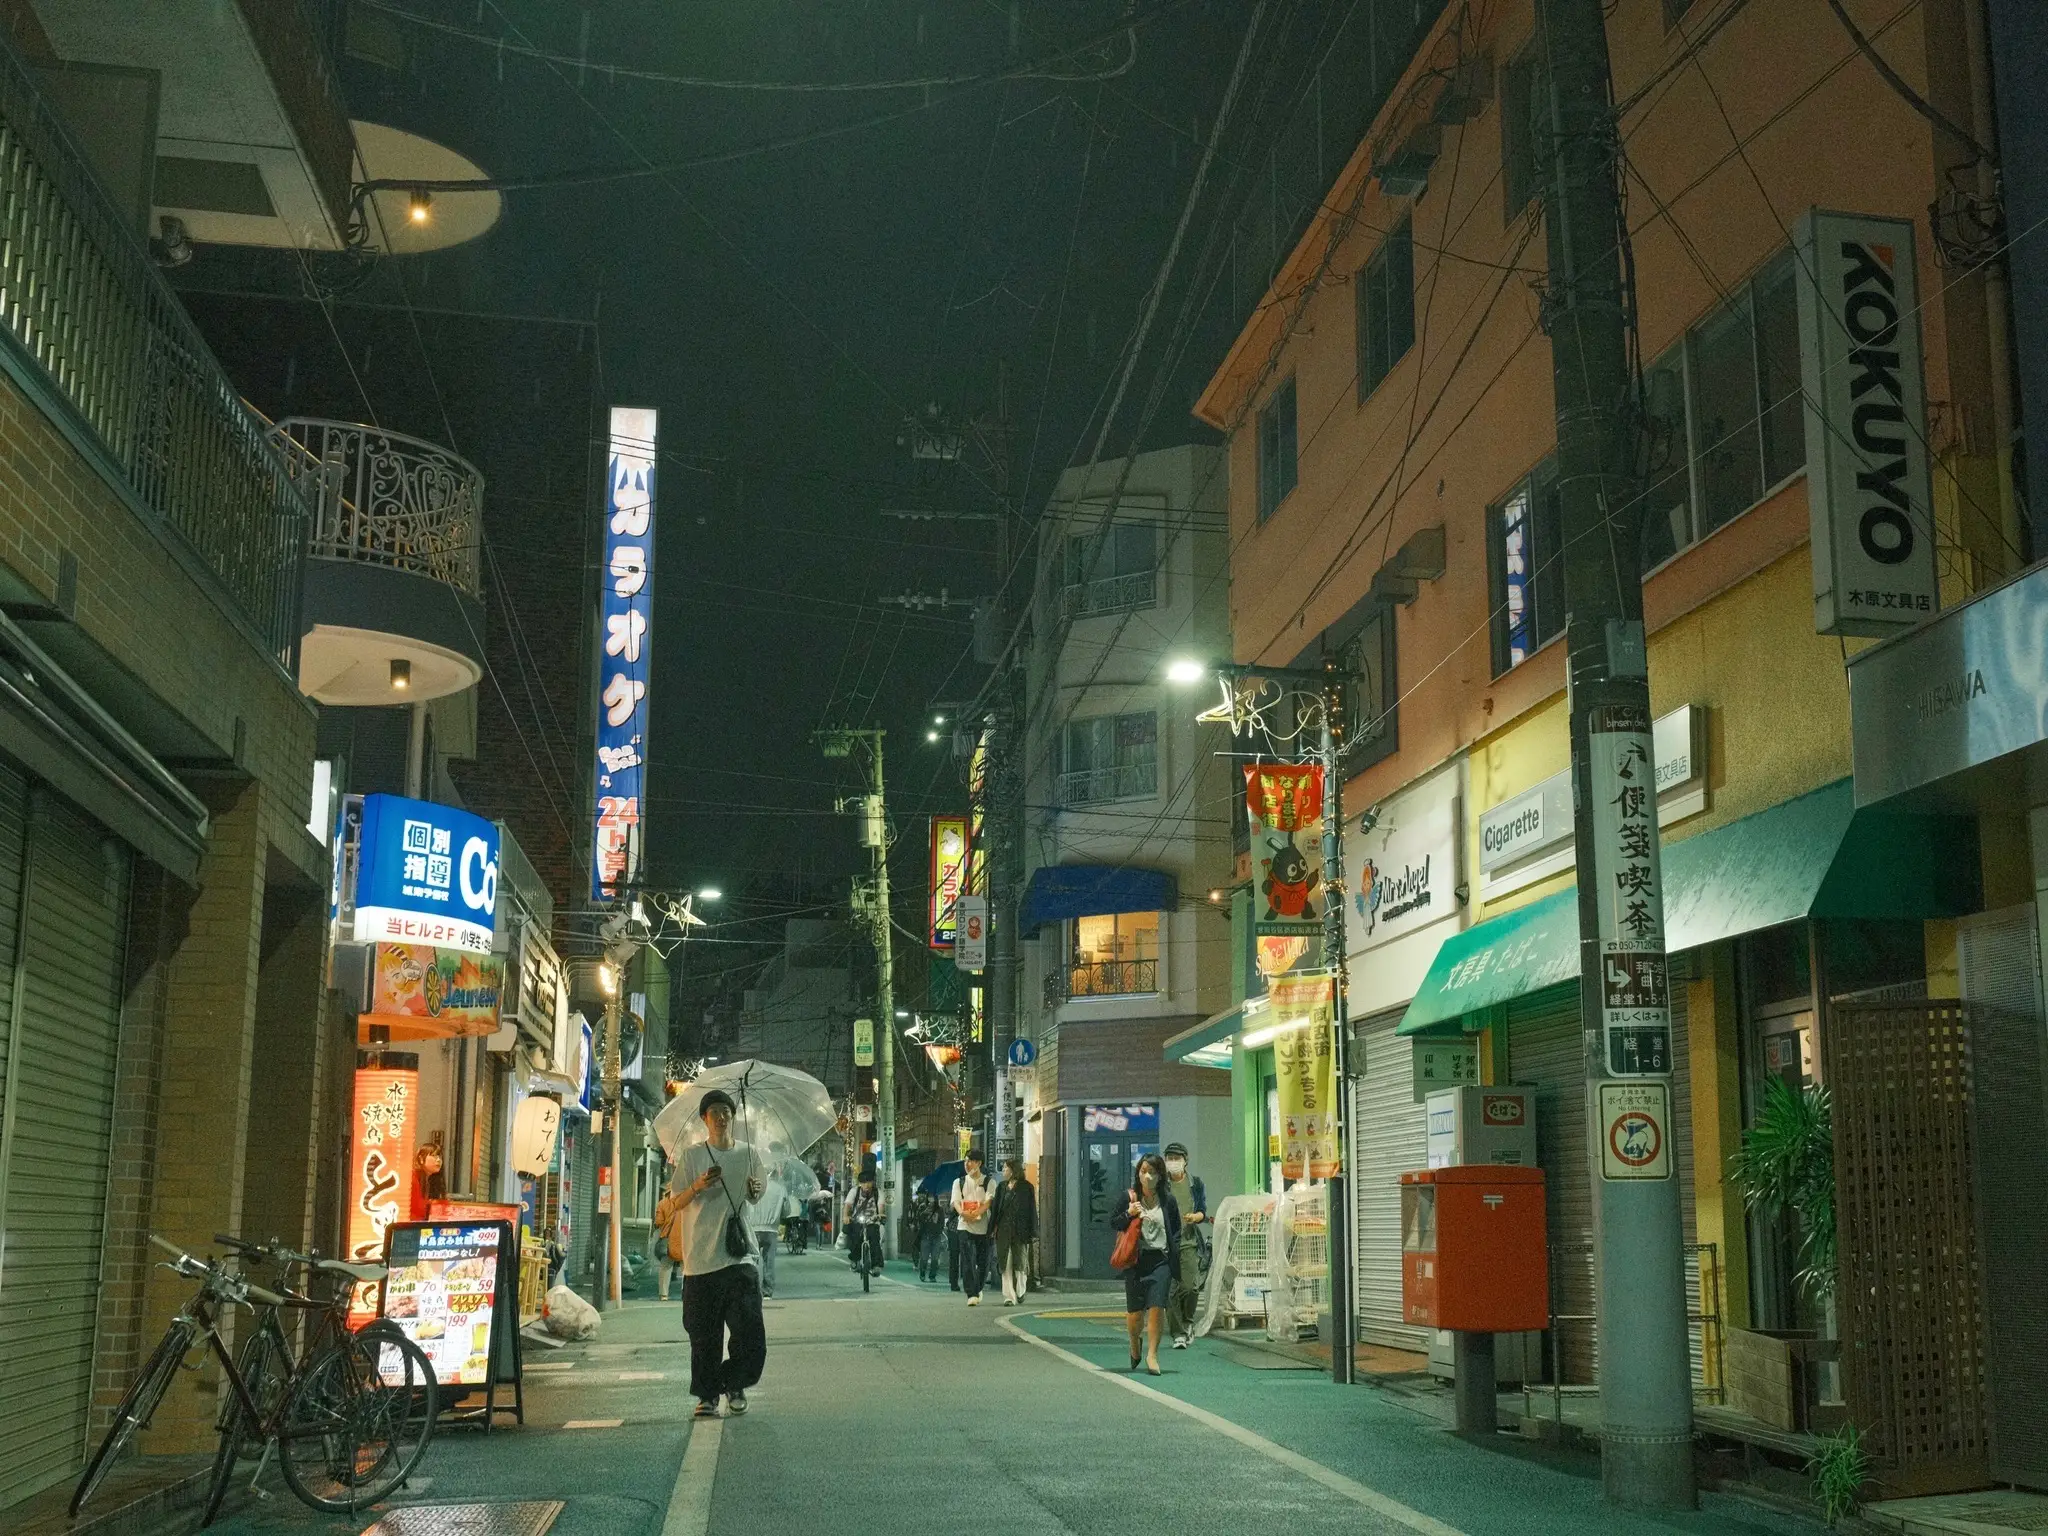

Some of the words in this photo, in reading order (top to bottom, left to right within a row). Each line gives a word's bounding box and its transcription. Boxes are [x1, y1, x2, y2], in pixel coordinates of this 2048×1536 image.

[1841, 240, 1915, 565] KOKUYO
[602, 487, 651, 728] カラオケ
[1848, 588, 1930, 611] 木原文具店
[1260, 773, 1279, 828] 商店街
[1279, 775, 1296, 828] なります
[1298, 774, 1314, 827] 頼りに
[405, 821, 451, 855] 個別
[1484, 806, 1540, 852] Cigarette
[404, 854, 451, 887] 指導
[460, 836, 498, 916] Co
[1610, 786, 1656, 936] 便箋喫茶
[1439, 932, 1548, 994] 文房具・たばこ
[1624, 1036, 1663, 1051] 経堂
[1633, 1055, 1662, 1068] 1-6
[386, 1082, 407, 1138] 水炊き
[1489, 1103, 1518, 1117] たばこ
[536, 1109, 556, 1163] おでん
[477, 1231, 497, 1242] 999
[477, 1279, 494, 1292] 59
[447, 1315, 468, 1327] 199
